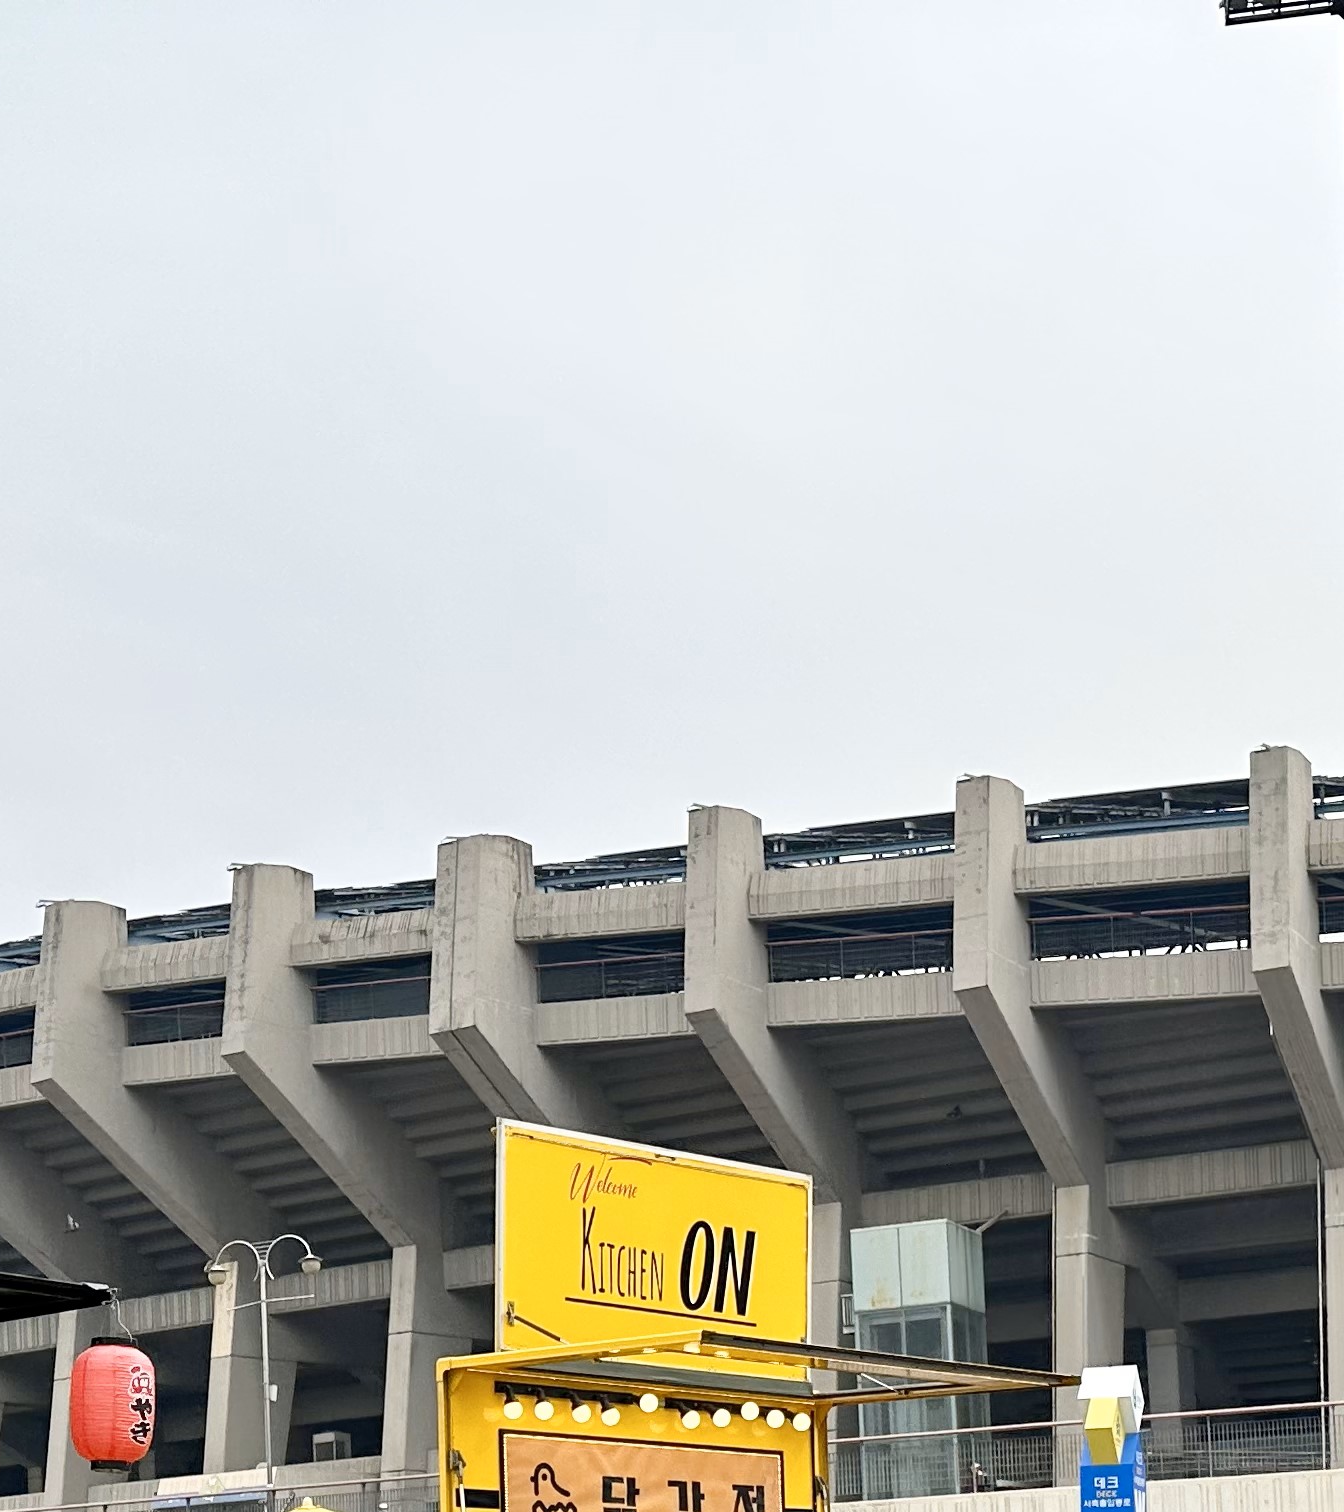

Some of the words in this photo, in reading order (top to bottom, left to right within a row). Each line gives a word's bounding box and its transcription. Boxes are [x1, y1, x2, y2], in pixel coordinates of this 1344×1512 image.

[570, 1157, 638, 1204] Welcome
[680, 1220, 756, 1316] ON
[1094, 1476, 1119, 1489] 데크
